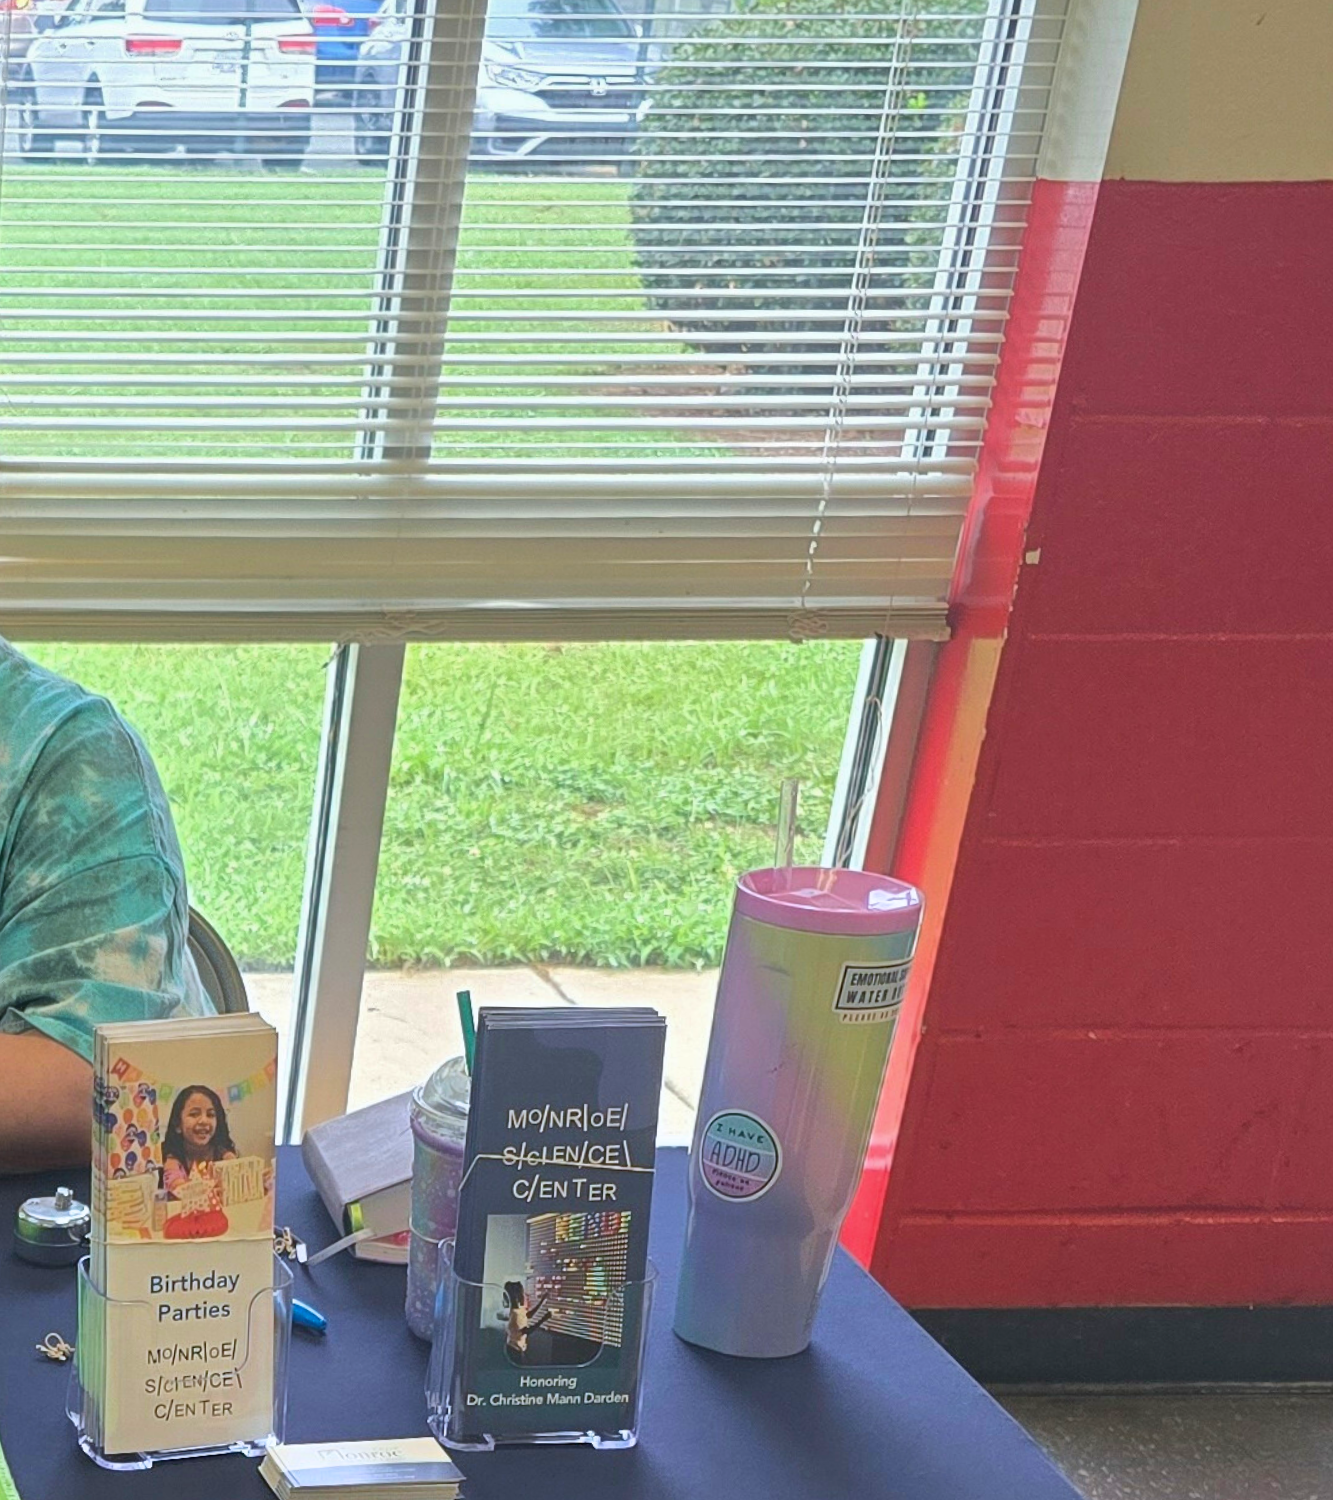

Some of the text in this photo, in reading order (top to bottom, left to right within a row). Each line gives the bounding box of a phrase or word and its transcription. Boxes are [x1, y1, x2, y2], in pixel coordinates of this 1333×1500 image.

[846, 988, 889, 1004] WATER
[717, 1122, 764, 1143] I HAVE
[709, 1140, 761, 1173] ADHD
[149, 1273, 241, 1295] Birthday
[157, 1303, 231, 1323] Parties
[519, 1374, 578, 1390] Honoring
[467, 1391, 630, 1407] Dr. Christine Mann Darden
